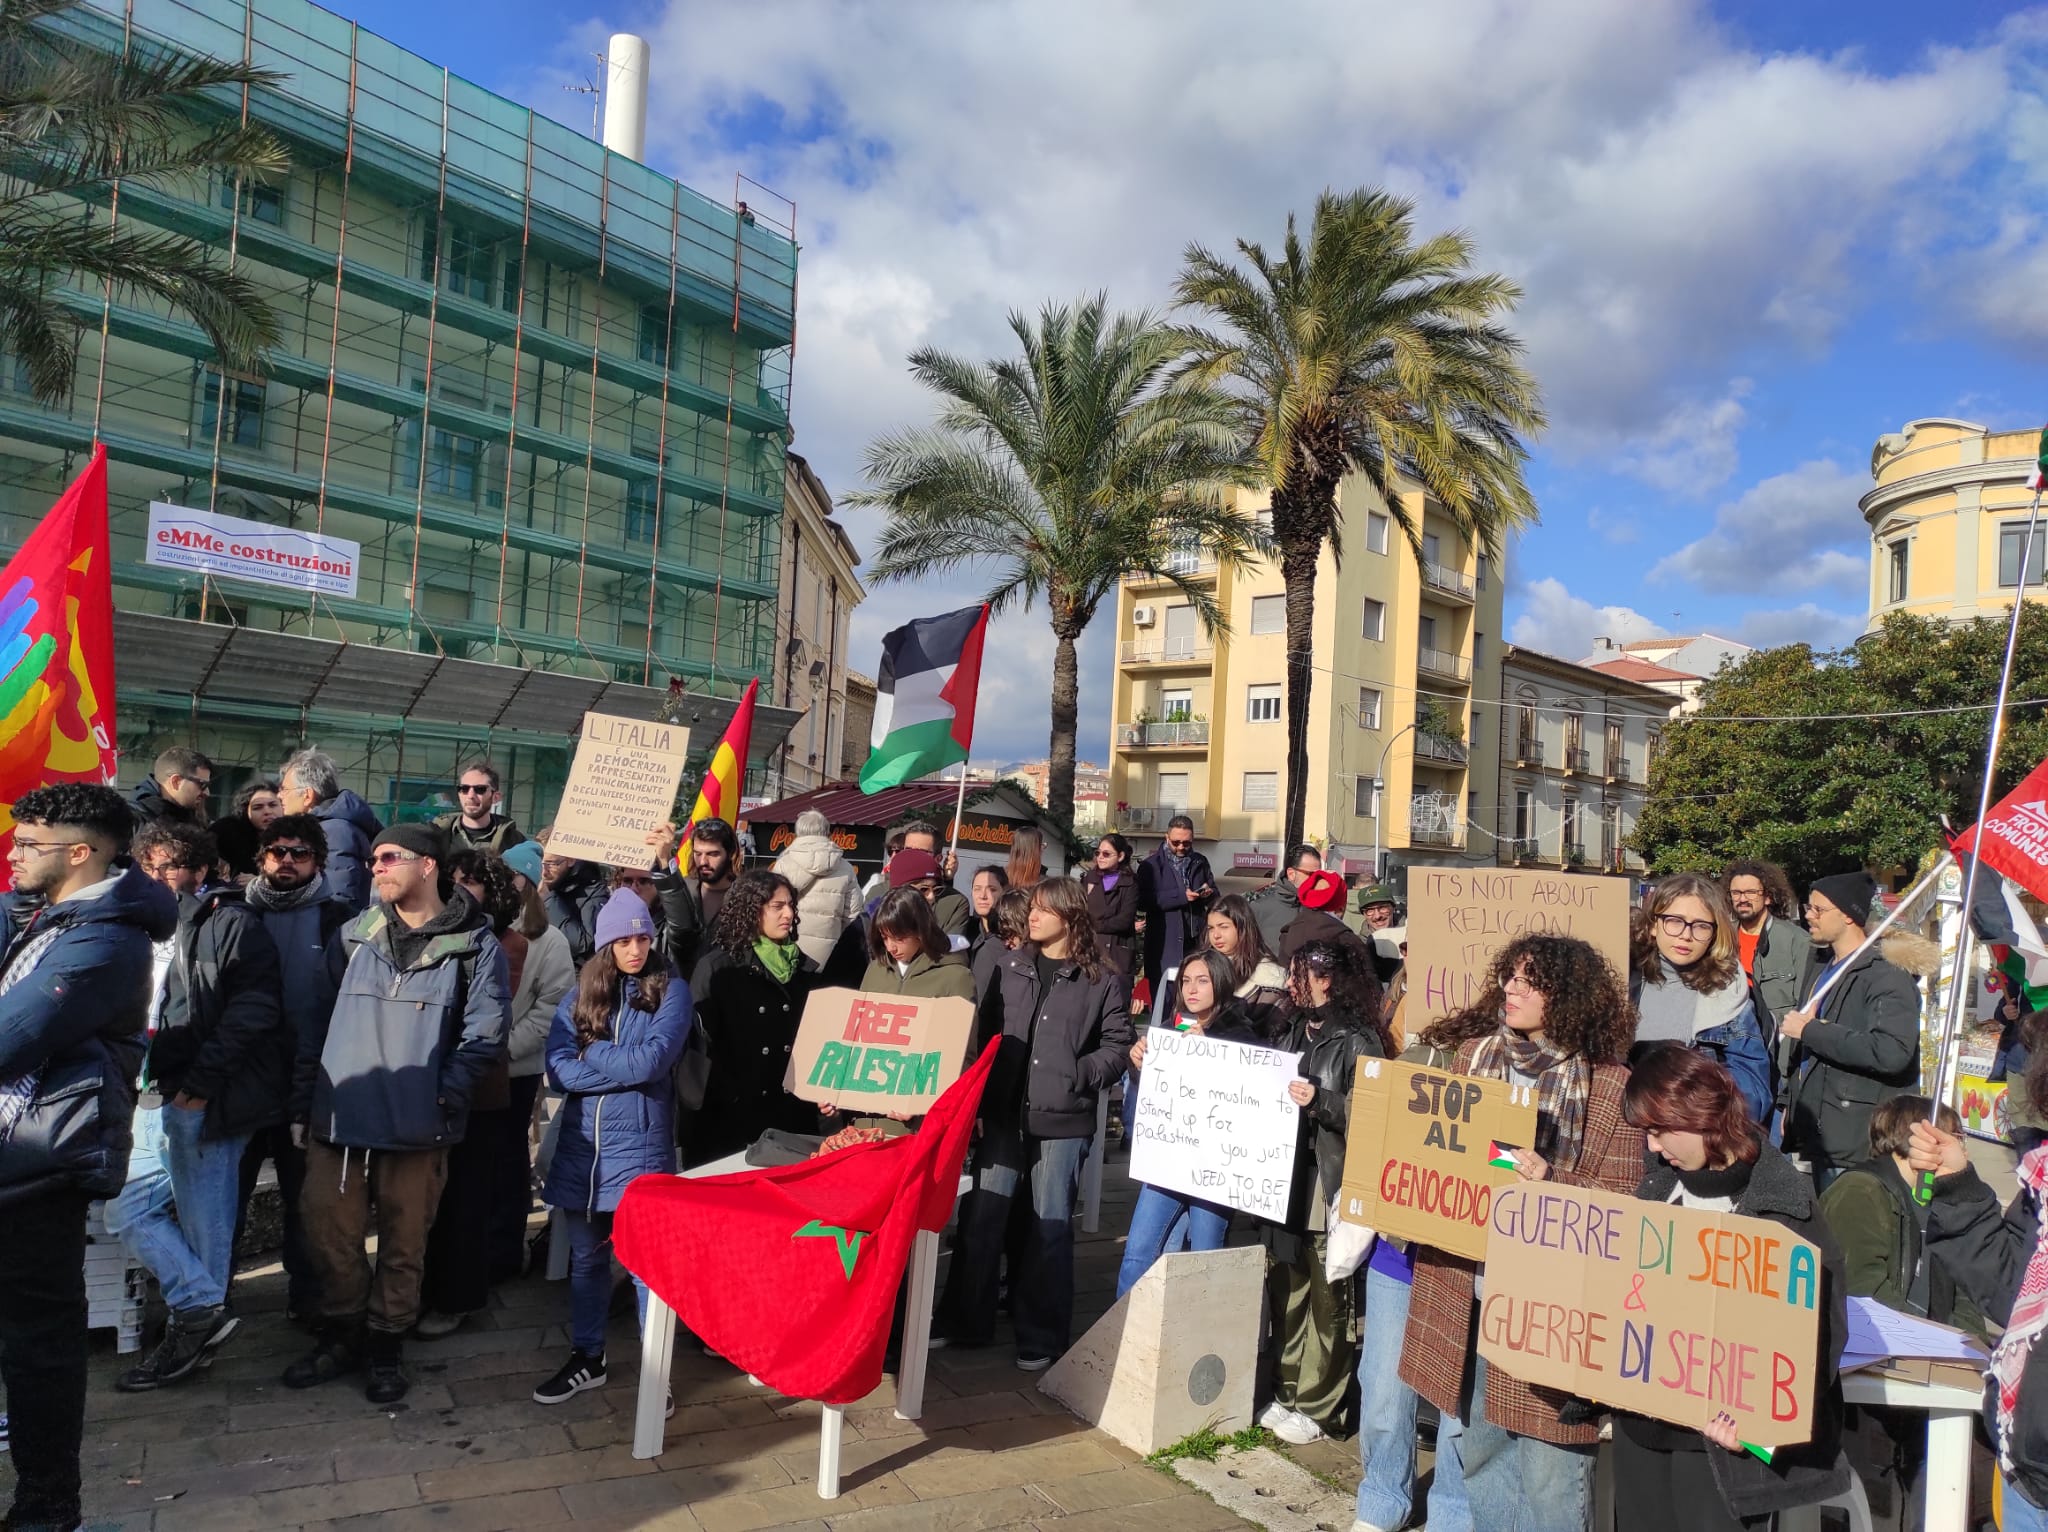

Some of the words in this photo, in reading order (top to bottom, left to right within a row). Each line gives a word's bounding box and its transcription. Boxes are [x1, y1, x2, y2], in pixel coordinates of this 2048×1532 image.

[157, 528, 224, 552] eMMe
[230, 544, 352, 576] costruzioni
[589, 718, 670, 750] L'ITALIA
[595, 753, 667, 774] DEMOCRAZIA
[630, 749, 648, 760] UNA
[588, 762, 671, 785] RAPPRESENTATIVA
[590, 775, 664, 795] PRINCIPALMENTE
[573, 784, 598, 798] DEGLI
[599, 788, 635, 801] INTERESSI
[576, 808, 592, 816] CON
[605, 813, 657, 833] ISRAELE
[624, 806, 659, 818] RAPPORTI
[560, 833, 597, 847] ABBIAMO
[608, 844, 645, 854] GOVERNO
[2006, 813, 2048, 847] FRON
[604, 851, 651, 868] RAZZISTA
[1236, 854, 1274, 866] amplifon
[1472, 874, 1521, 901] NOT
[1532, 879, 1599, 911] ABOUT
[1442, 906, 1573, 938] RELIGION
[842, 999, 919, 1046] FREE
[807, 1041, 942, 1096] PALESTINA
[1186, 1040, 1230, 1061] DON'T
[1239, 1046, 1284, 1067] NEED
[1179, 1075, 1197, 1099] be
[1208, 1084, 1261, 1107] muslim
[1275, 1091, 1294, 1114] to
[1408, 1072, 1483, 1124] STOP
[1183, 1112, 1198, 1133] up
[1206, 1105, 1233, 1133] for
[1423, 1120, 1467, 1154] AL
[1191, 1169, 1226, 1186] NEED
[1232, 1173, 1255, 1190] TO
[1261, 1178, 1289, 1195] BE
[1380, 1158, 1492, 1228] GENOCIDIO
[1228, 1187, 1286, 1217] HUMAN
[1493, 1189, 1625, 1261] GUERRE
[1638, 1215, 1675, 1275] DI
[1688, 1228, 1781, 1299] SERIE
[1786, 1244, 1816, 1310] A
[1623, 1273, 1648, 1312] &
[1481, 1293, 1608, 1372] GUERRE
[1619, 1319, 1655, 1384] DI
[1658, 1329, 1760, 1413] SERIE
[1770, 1351, 1799, 1422] B
